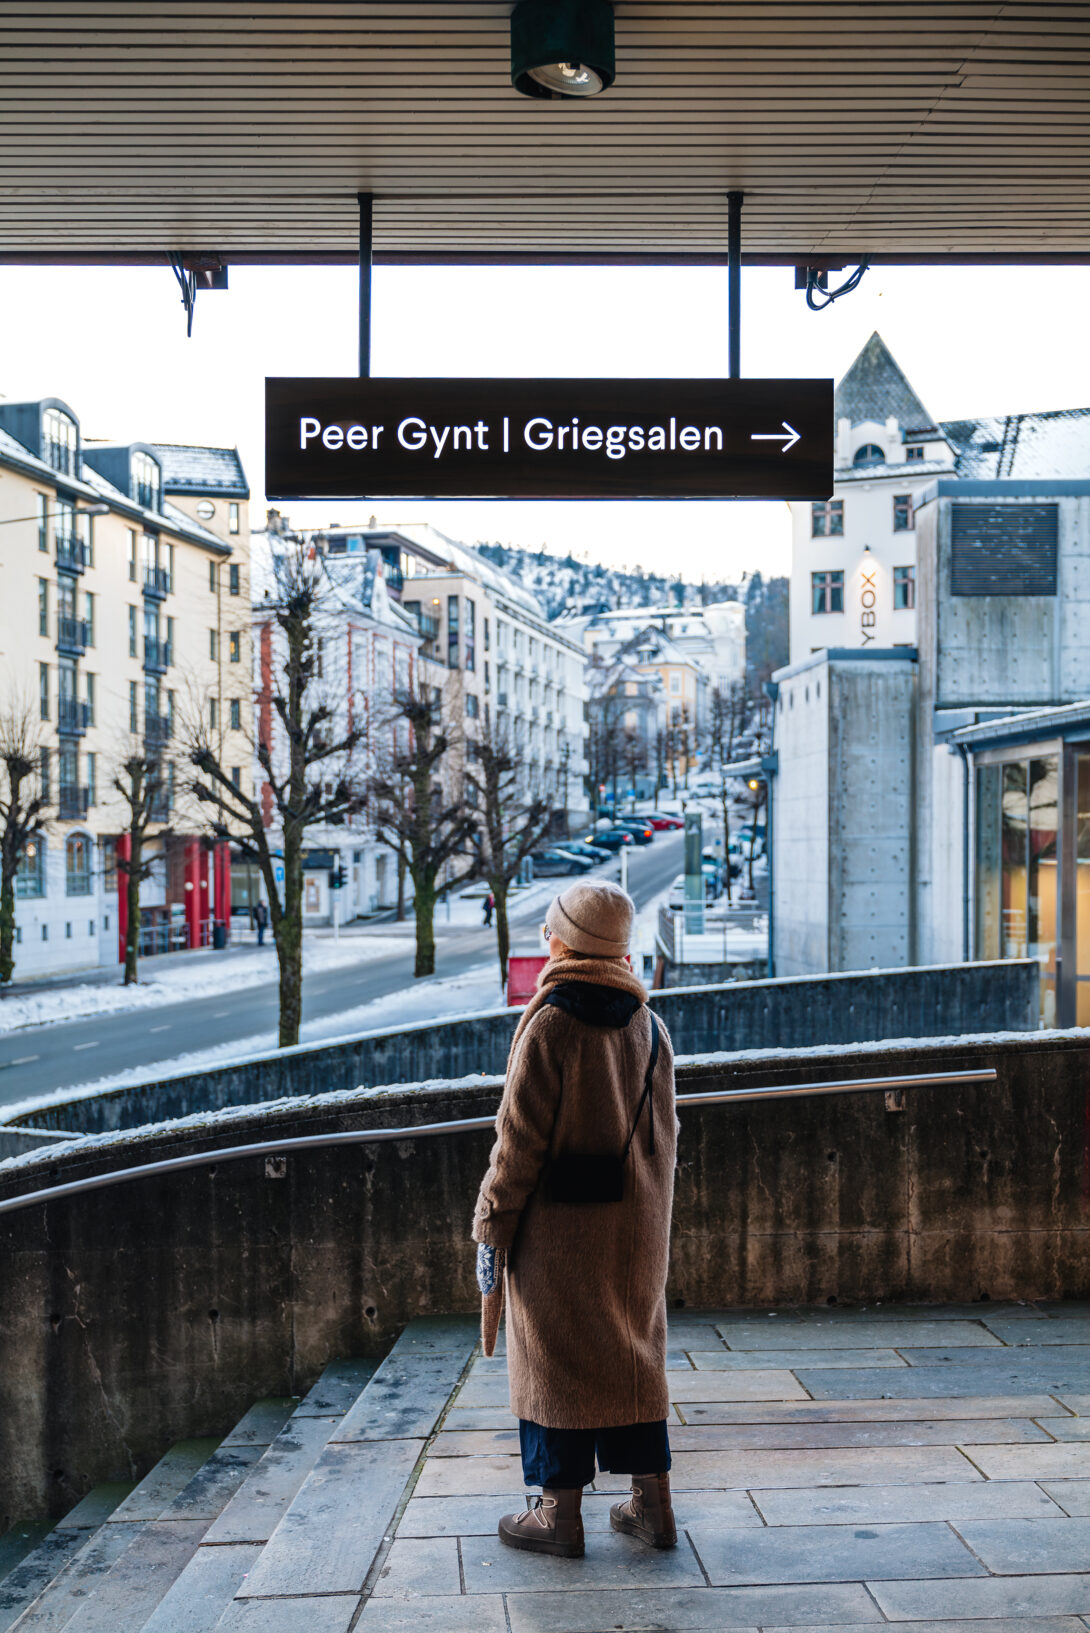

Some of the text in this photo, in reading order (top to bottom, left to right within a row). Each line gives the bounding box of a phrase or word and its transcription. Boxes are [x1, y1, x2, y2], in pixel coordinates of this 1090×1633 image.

[300, 417, 384, 450] Peer
[397, 417, 489, 459] Gynt
[523, 417, 723, 460] Griegsalen
